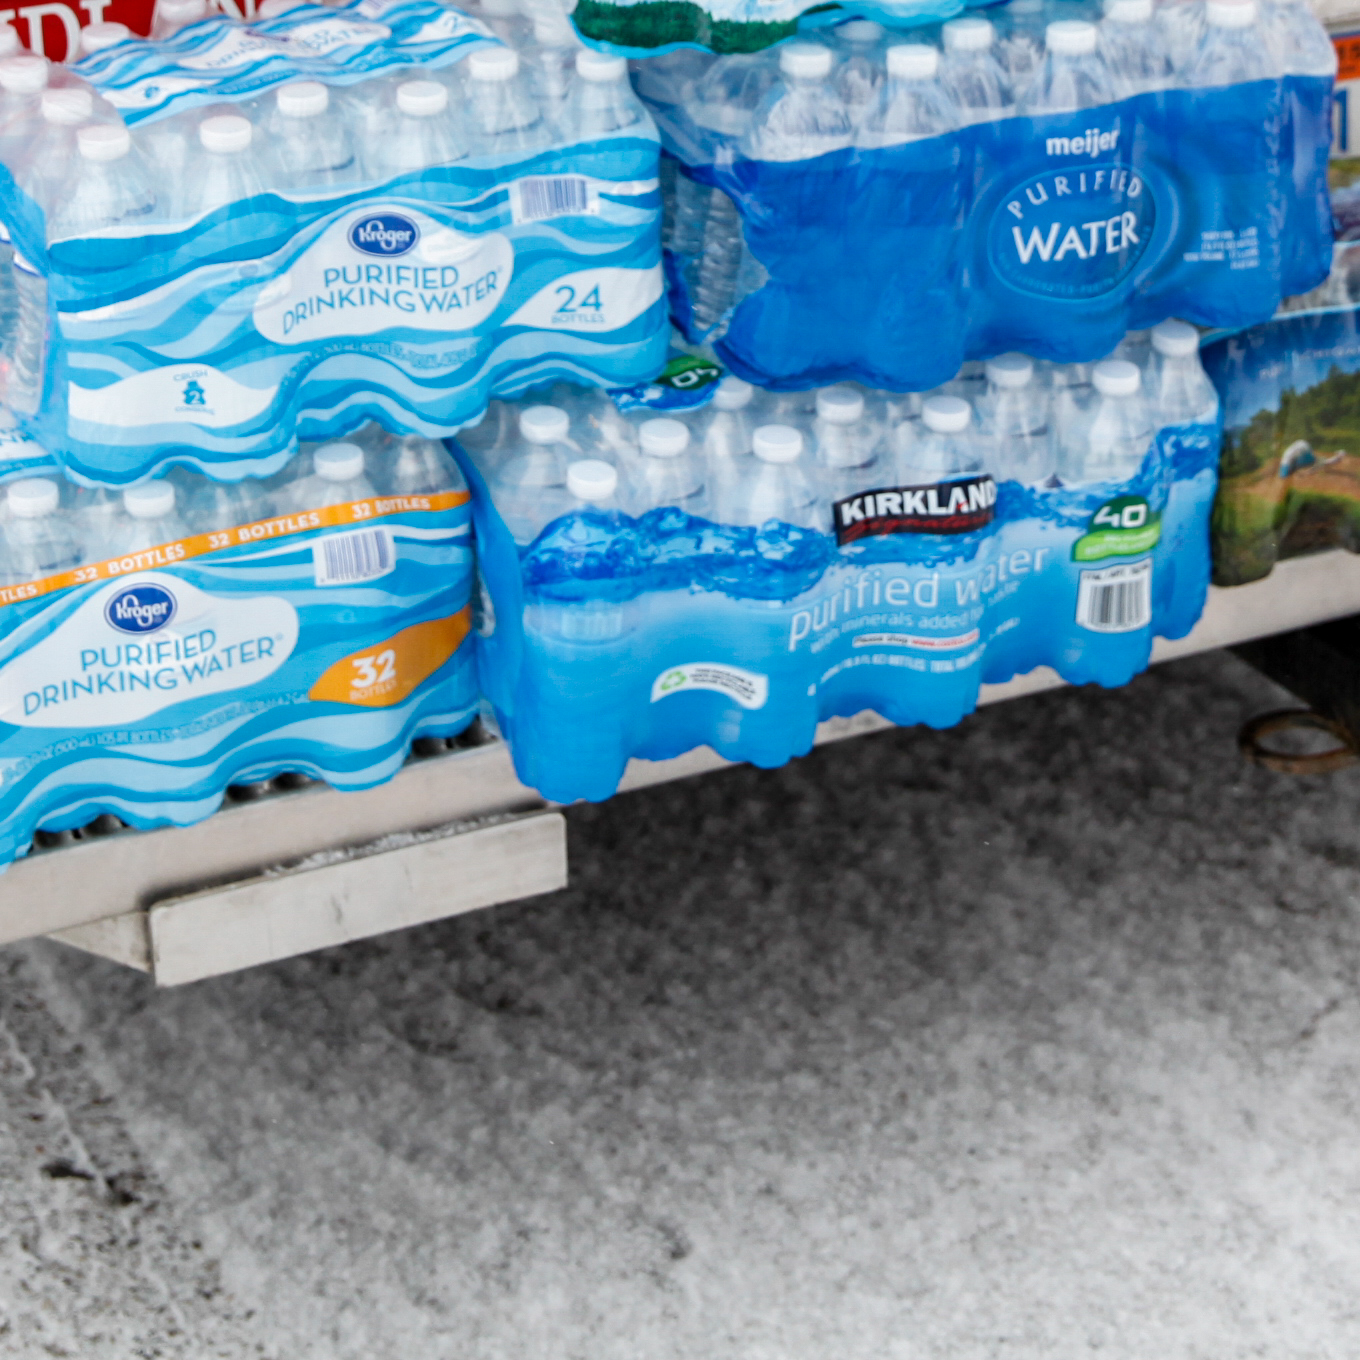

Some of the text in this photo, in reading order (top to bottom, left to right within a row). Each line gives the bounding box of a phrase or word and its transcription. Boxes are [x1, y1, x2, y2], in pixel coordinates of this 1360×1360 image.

[1045, 128, 1120, 158] meijer
[1006, 169, 1141, 220] PURIFIED
[357, 219, 413, 250] Kroger
[1011, 210, 1140, 265] WATER
[323, 263, 460, 289] PURIFIED
[554, 282, 605, 314] 24
[282, 270, 498, 336] DRINKING WATER
[840, 479, 998, 527] KIRKLAND
[1093, 503, 1148, 529] 40
[74, 566, 100, 583] 32
[107, 543, 187, 575] BOTTLES
[208, 533, 231, 549] 32
[238, 512, 322, 543] BOTTLES
[352, 504, 372, 519] 32
[374, 497, 432, 515] BOTTLES
[114, 593, 170, 628] Kroger
[788, 546, 1051, 653] purified water
[80, 628, 217, 673] PURIFIED
[350, 648, 397, 689] 32
[22, 666, 179, 718] DRINKING
[181, 635, 276, 684] WATER
